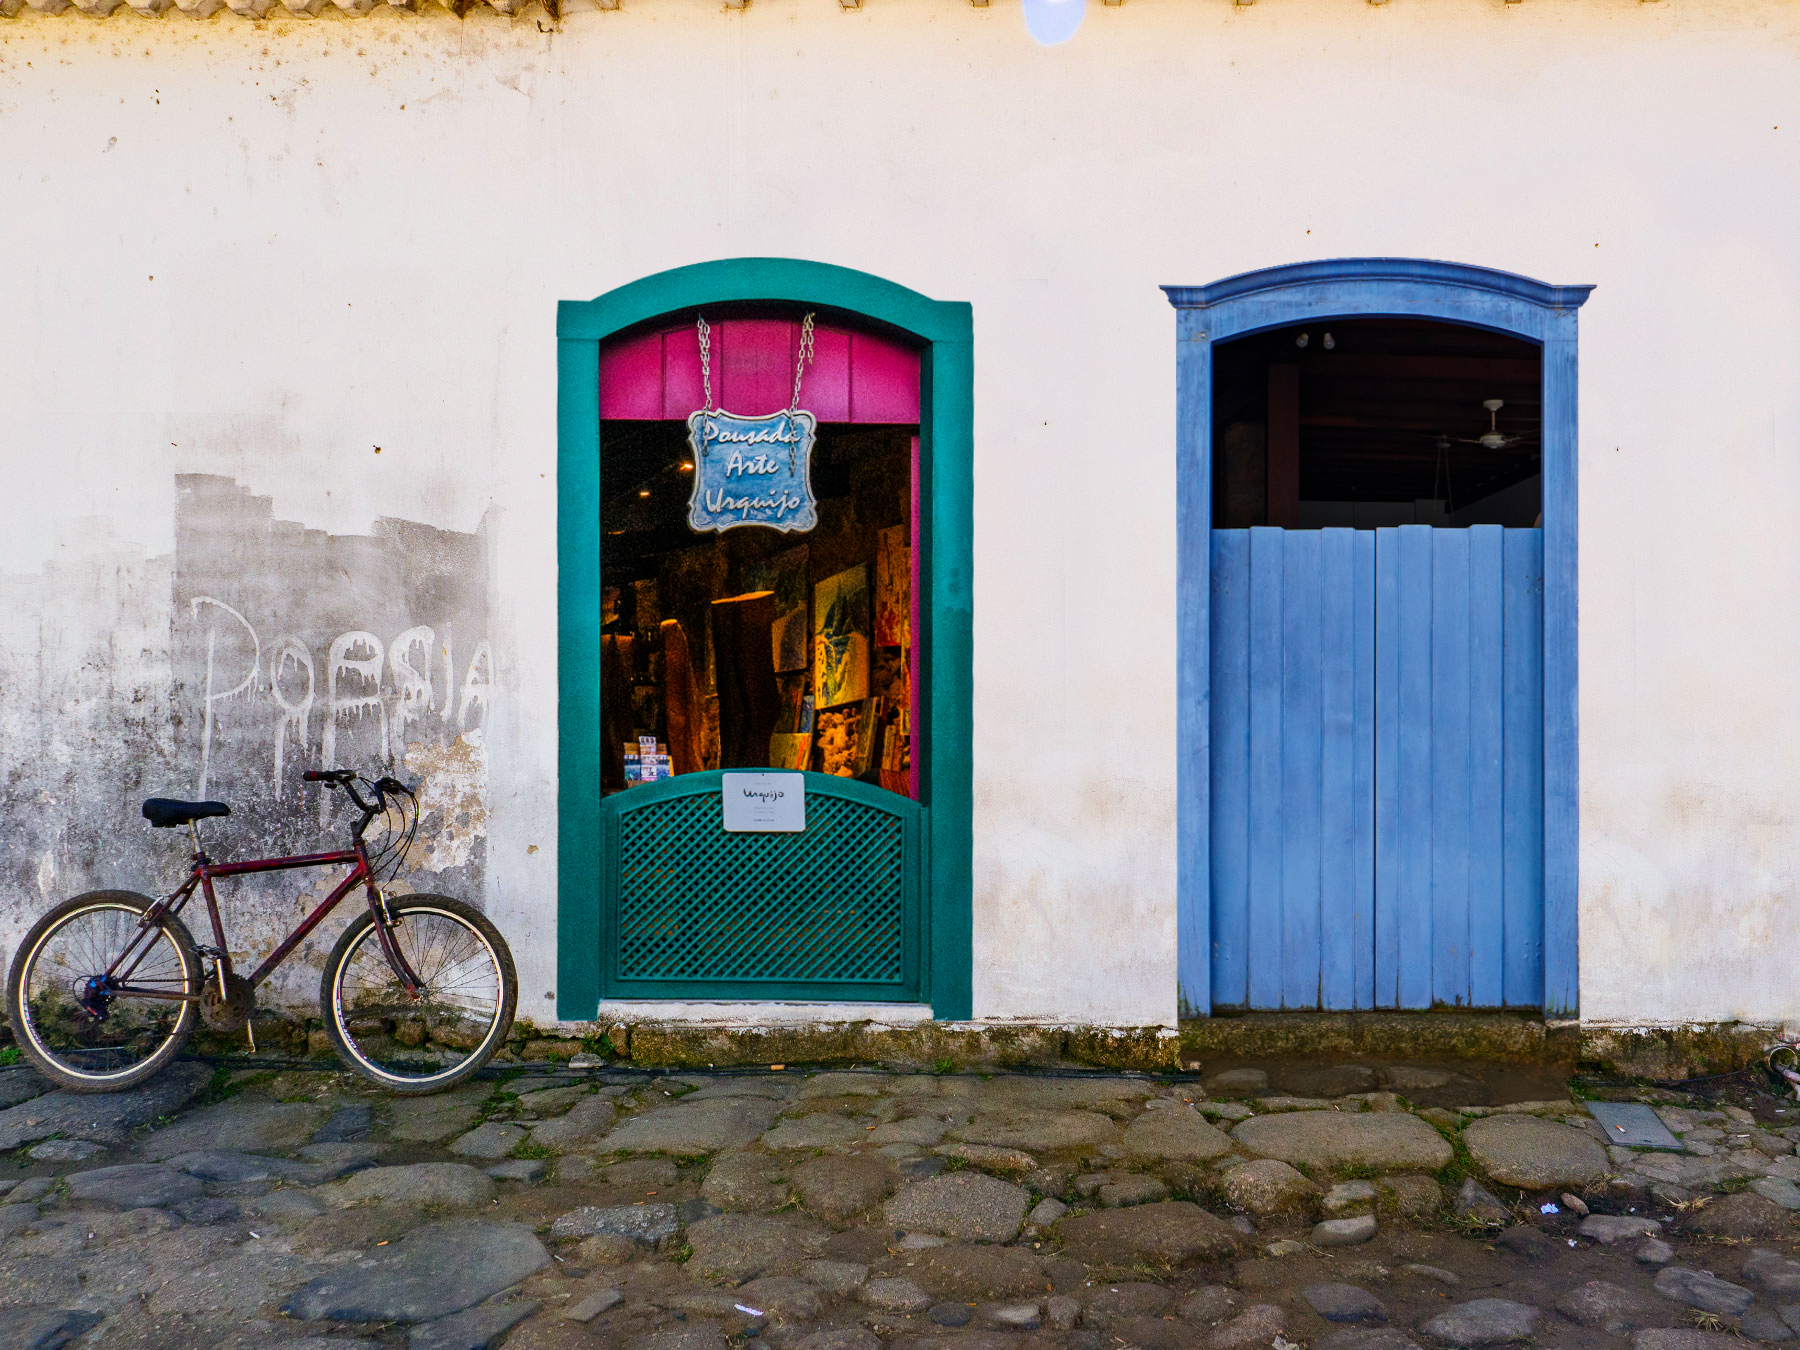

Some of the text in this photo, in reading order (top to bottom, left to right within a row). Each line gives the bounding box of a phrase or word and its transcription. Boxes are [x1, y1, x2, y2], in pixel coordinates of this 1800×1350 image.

[703, 420, 801, 445] Pousada
[726, 449, 780, 478] Arte
[705, 487, 801, 520] Urquijo
